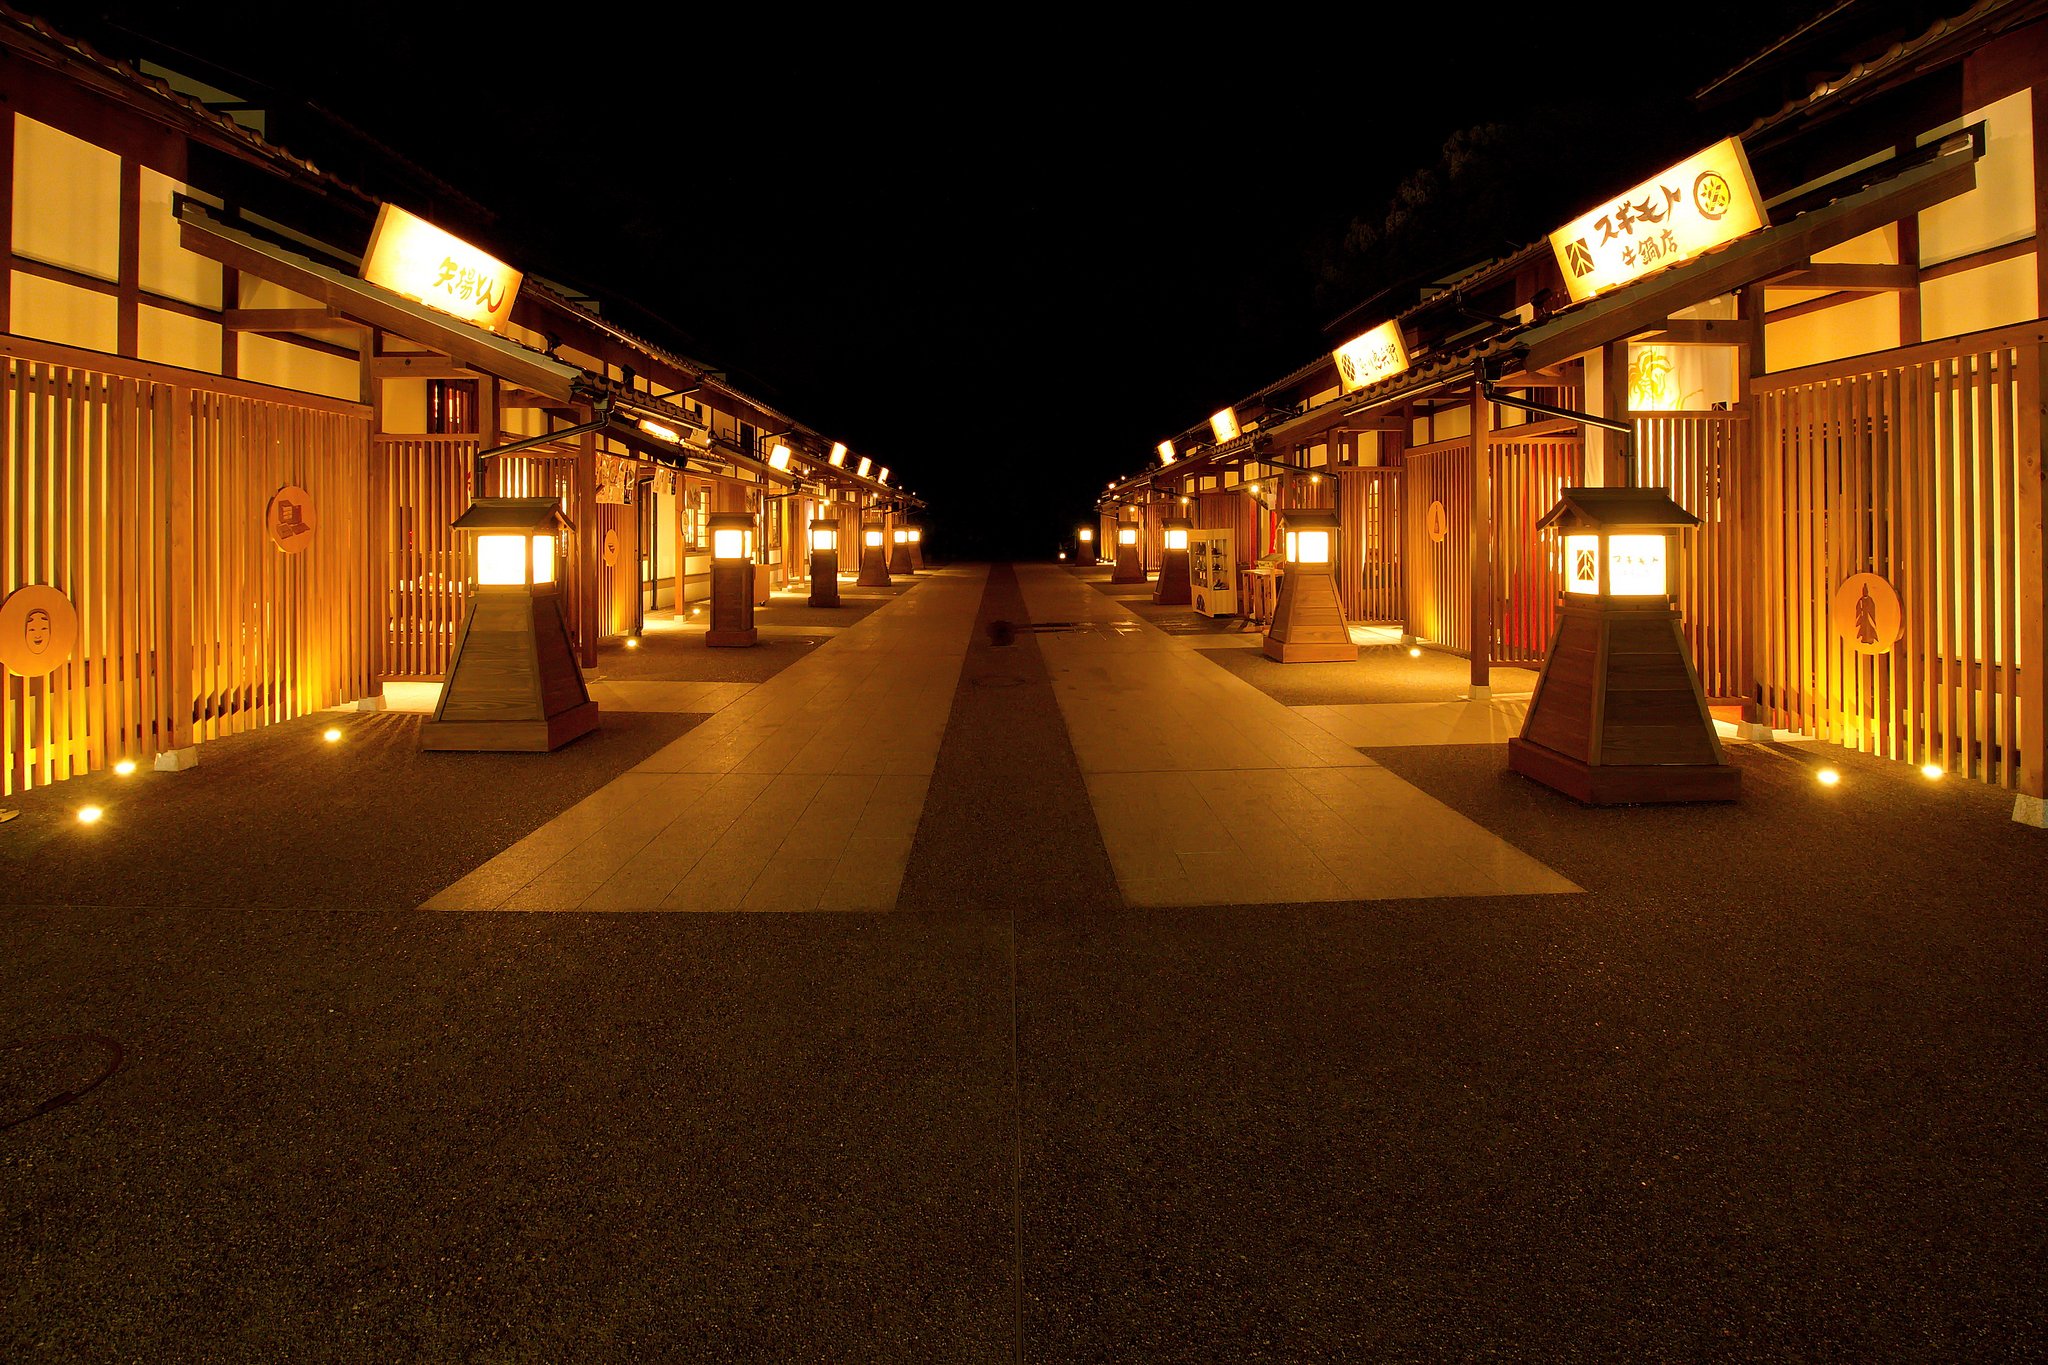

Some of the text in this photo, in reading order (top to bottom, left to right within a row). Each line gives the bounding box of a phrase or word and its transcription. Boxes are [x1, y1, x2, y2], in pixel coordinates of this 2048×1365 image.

[1593, 184, 1682, 247] スギモト
[1621, 228, 1679, 269] 牛鍋店
[433, 256, 506, 313] 矢場とん
